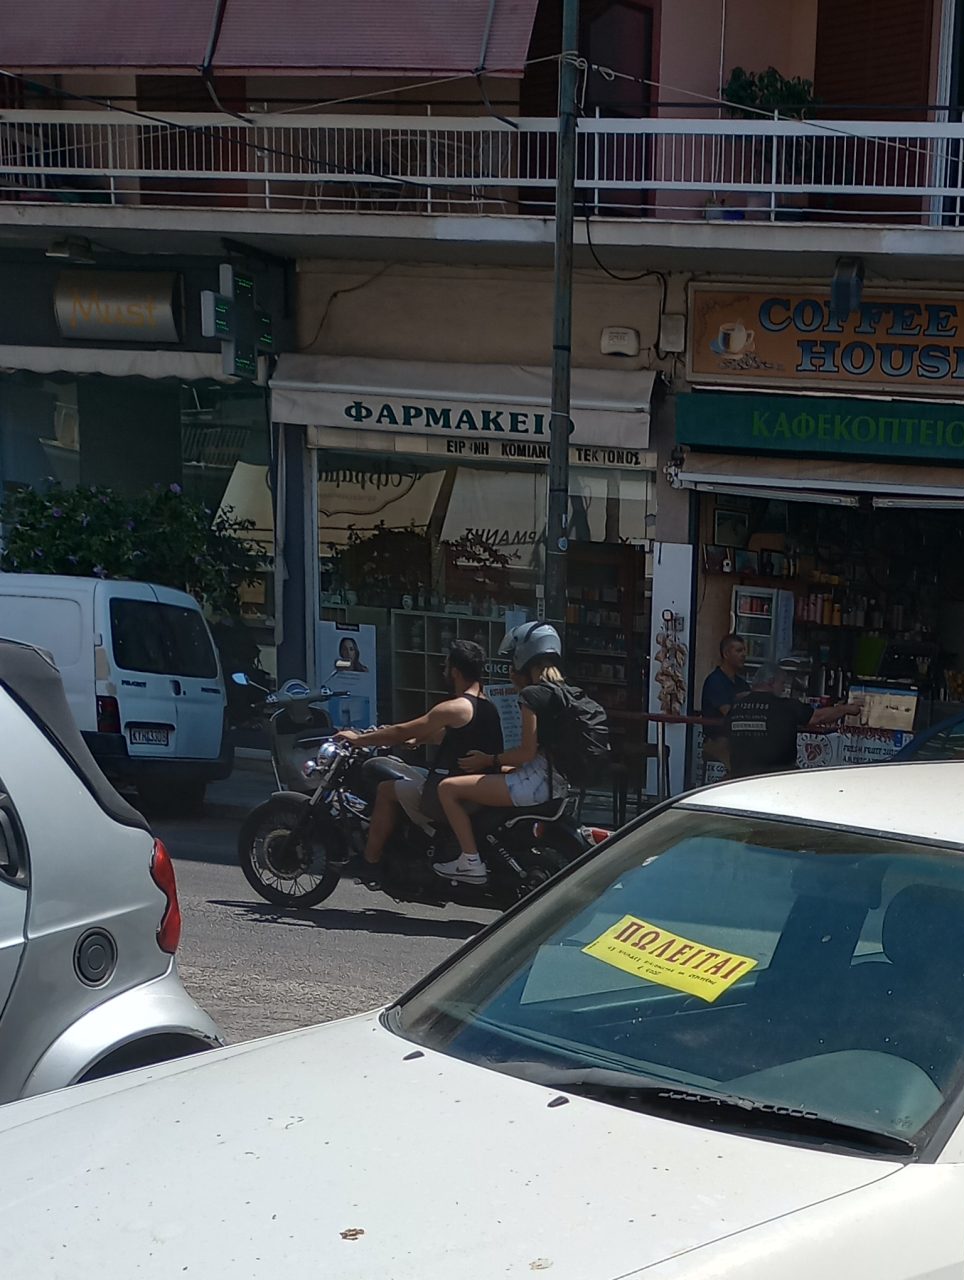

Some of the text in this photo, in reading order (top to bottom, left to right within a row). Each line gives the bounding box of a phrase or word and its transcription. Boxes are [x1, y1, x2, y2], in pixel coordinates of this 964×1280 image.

[69, 287, 157, 330] Must
[759, 297, 958, 337] COFFEE
[500, 443, 551, 460] ΚΟΜΙΑΝ
[614, 920, 748, 980] ΠΩΛΕΙΤΑΙ
